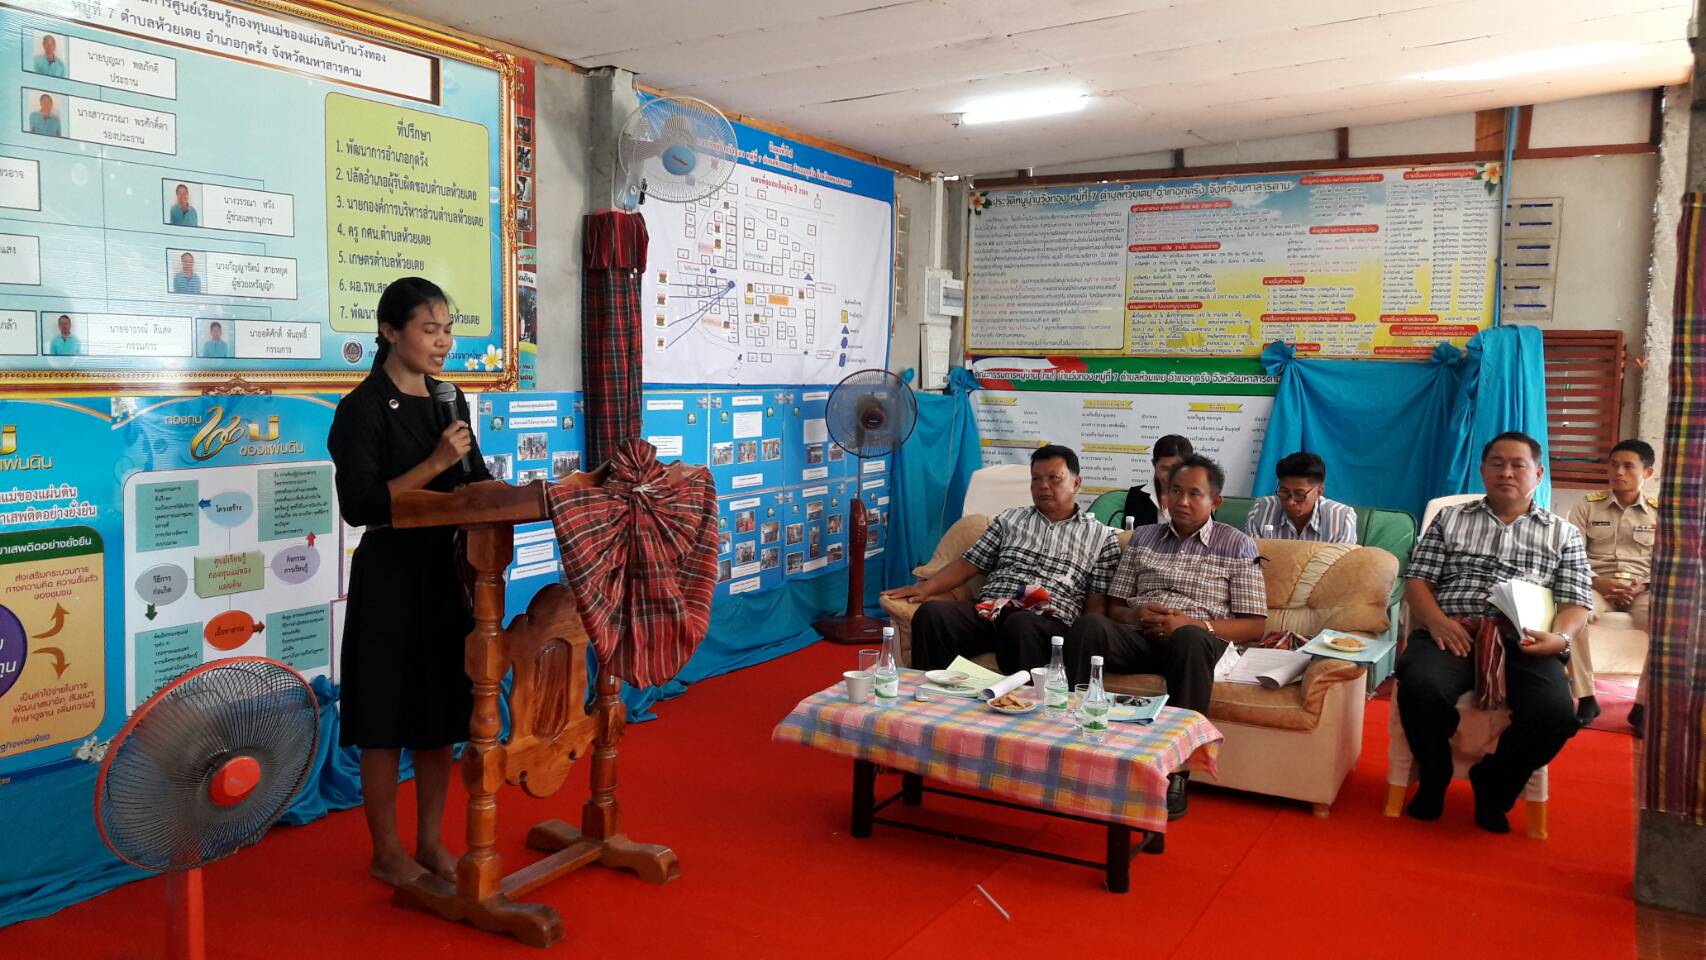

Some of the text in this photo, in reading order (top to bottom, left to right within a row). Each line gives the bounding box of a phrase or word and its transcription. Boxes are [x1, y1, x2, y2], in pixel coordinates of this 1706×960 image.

[108, 8, 114, 18] 7
[272, 46, 361, 77] จังหวัดมหาสารคาม
[397, 120, 431, 142] ที่ปรึกษา
[336, 140, 343, 153] 1.
[336, 168, 343, 180] 2.
[336, 195, 344, 209] 3.
[337, 224, 345, 237] 4.
[338, 251, 346, 263] 5.
[339, 279, 346, 291] 6.
[340, 306, 347, 319] 7.
[350, 302, 377, 319] พัฒนา
